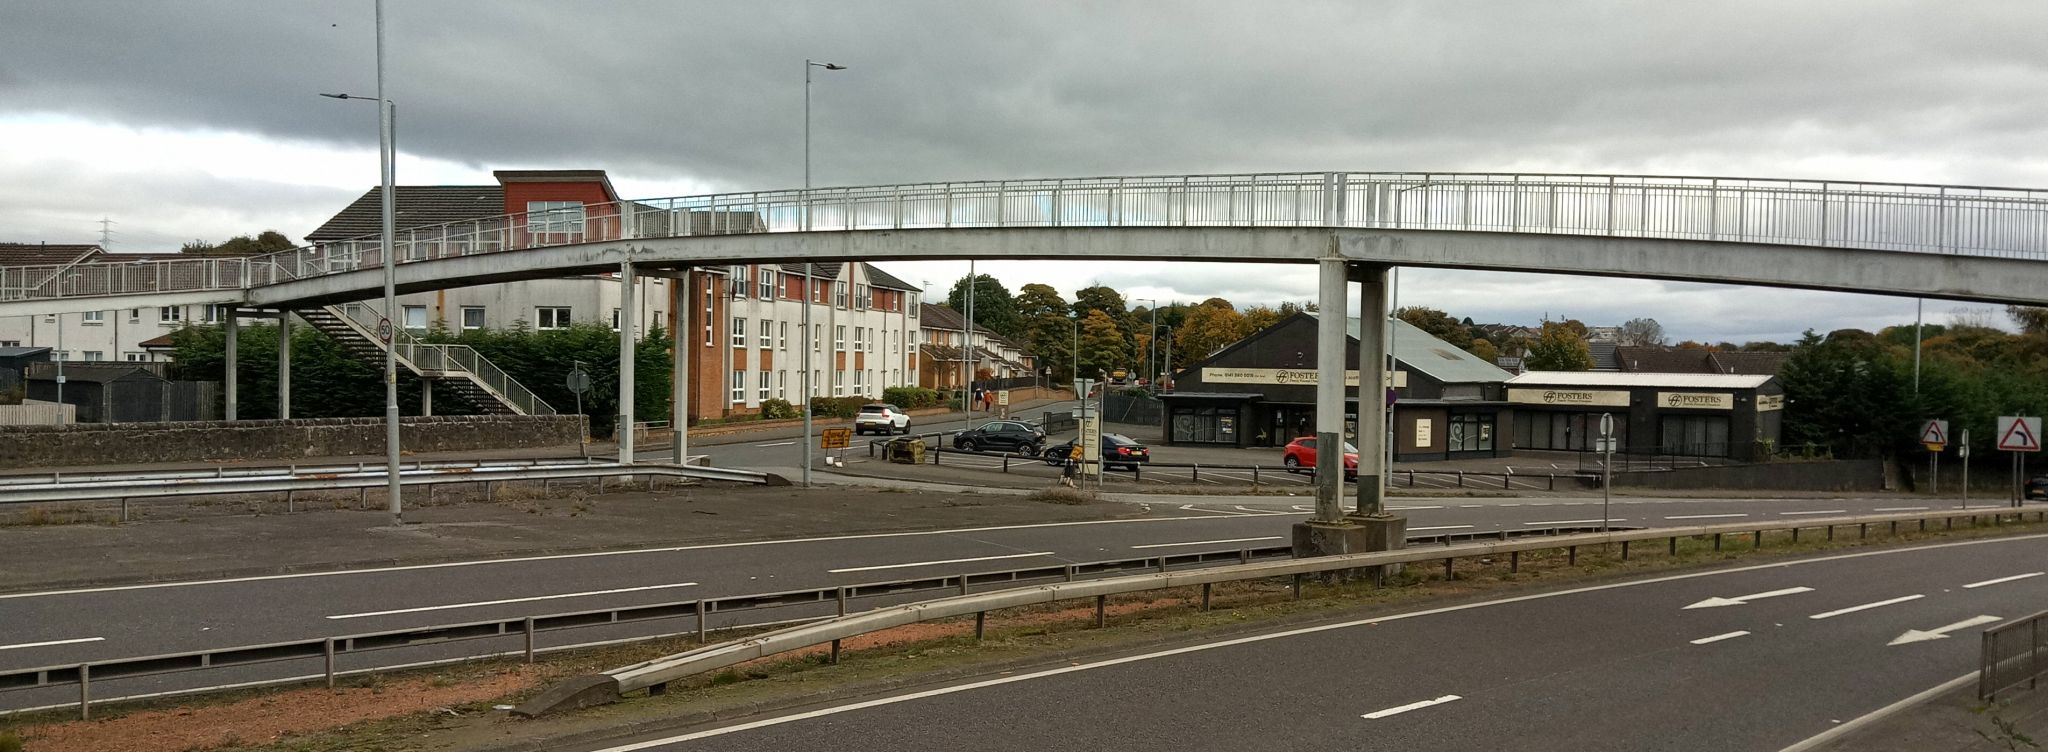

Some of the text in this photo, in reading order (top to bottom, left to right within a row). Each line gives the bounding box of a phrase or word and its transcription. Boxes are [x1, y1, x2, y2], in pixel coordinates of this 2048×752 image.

[381, 325, 390, 335] 50
[1557, 392, 1592, 400] FOSTERS
[1683, 395, 1722, 403] FOSTERS
